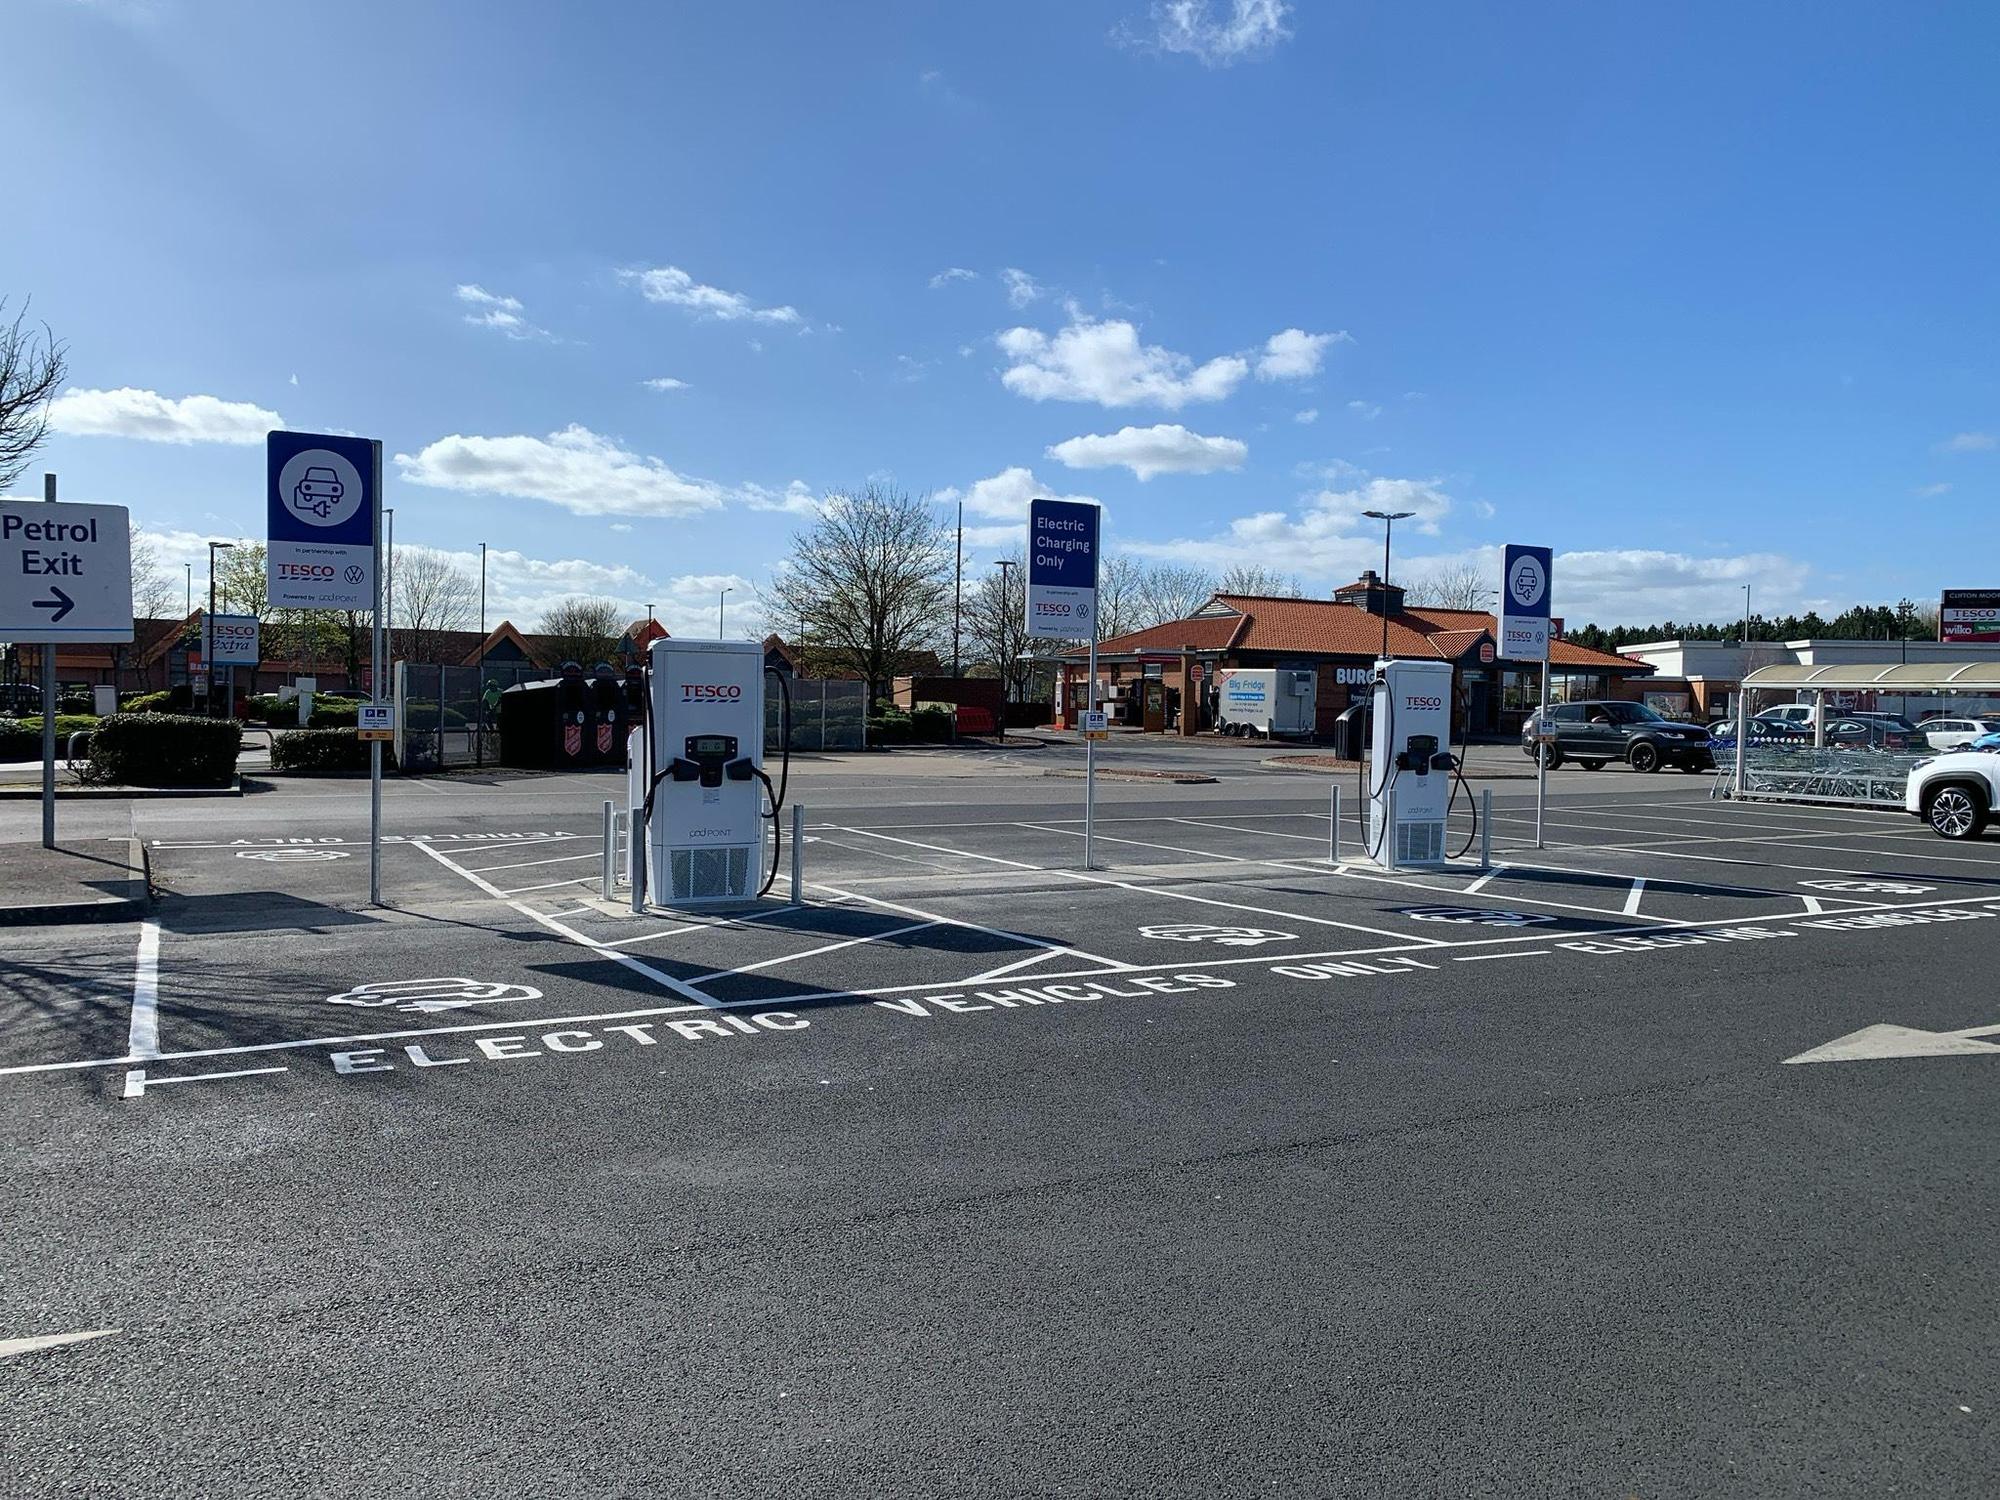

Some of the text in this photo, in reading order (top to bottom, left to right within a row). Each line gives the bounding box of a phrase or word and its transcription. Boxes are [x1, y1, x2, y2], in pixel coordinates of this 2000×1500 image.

[2, 515, 97, 543] Petrol
[1037, 517, 1085, 532] Electric
[1036, 536, 1090, 553] Charging
[21, 550, 83, 576] Exit
[1036, 554, 1065, 570] Only
[278, 563, 335, 577] TESCO
[1036, 602, 1071, 613] TESCO
[1953, 610, 1996, 618] TESCO
[1507, 631, 1532, 639] TESCO
[1944, 624, 1972, 635] wilko
[212, 639, 249, 650] extra
[1336, 668, 1376, 685] BURG
[681, 685, 741, 698] TESCO
[1229, 680, 1266, 691] Big Fridge
[1406, 697, 1441, 706] TESCO
[230, 837, 345, 845] ONLY
[1555, 908, 1997, 955] ELECTRIC VEHICLES
[329, 956, 1439, 1075] ELECTRIC VEHICLES ONLY
